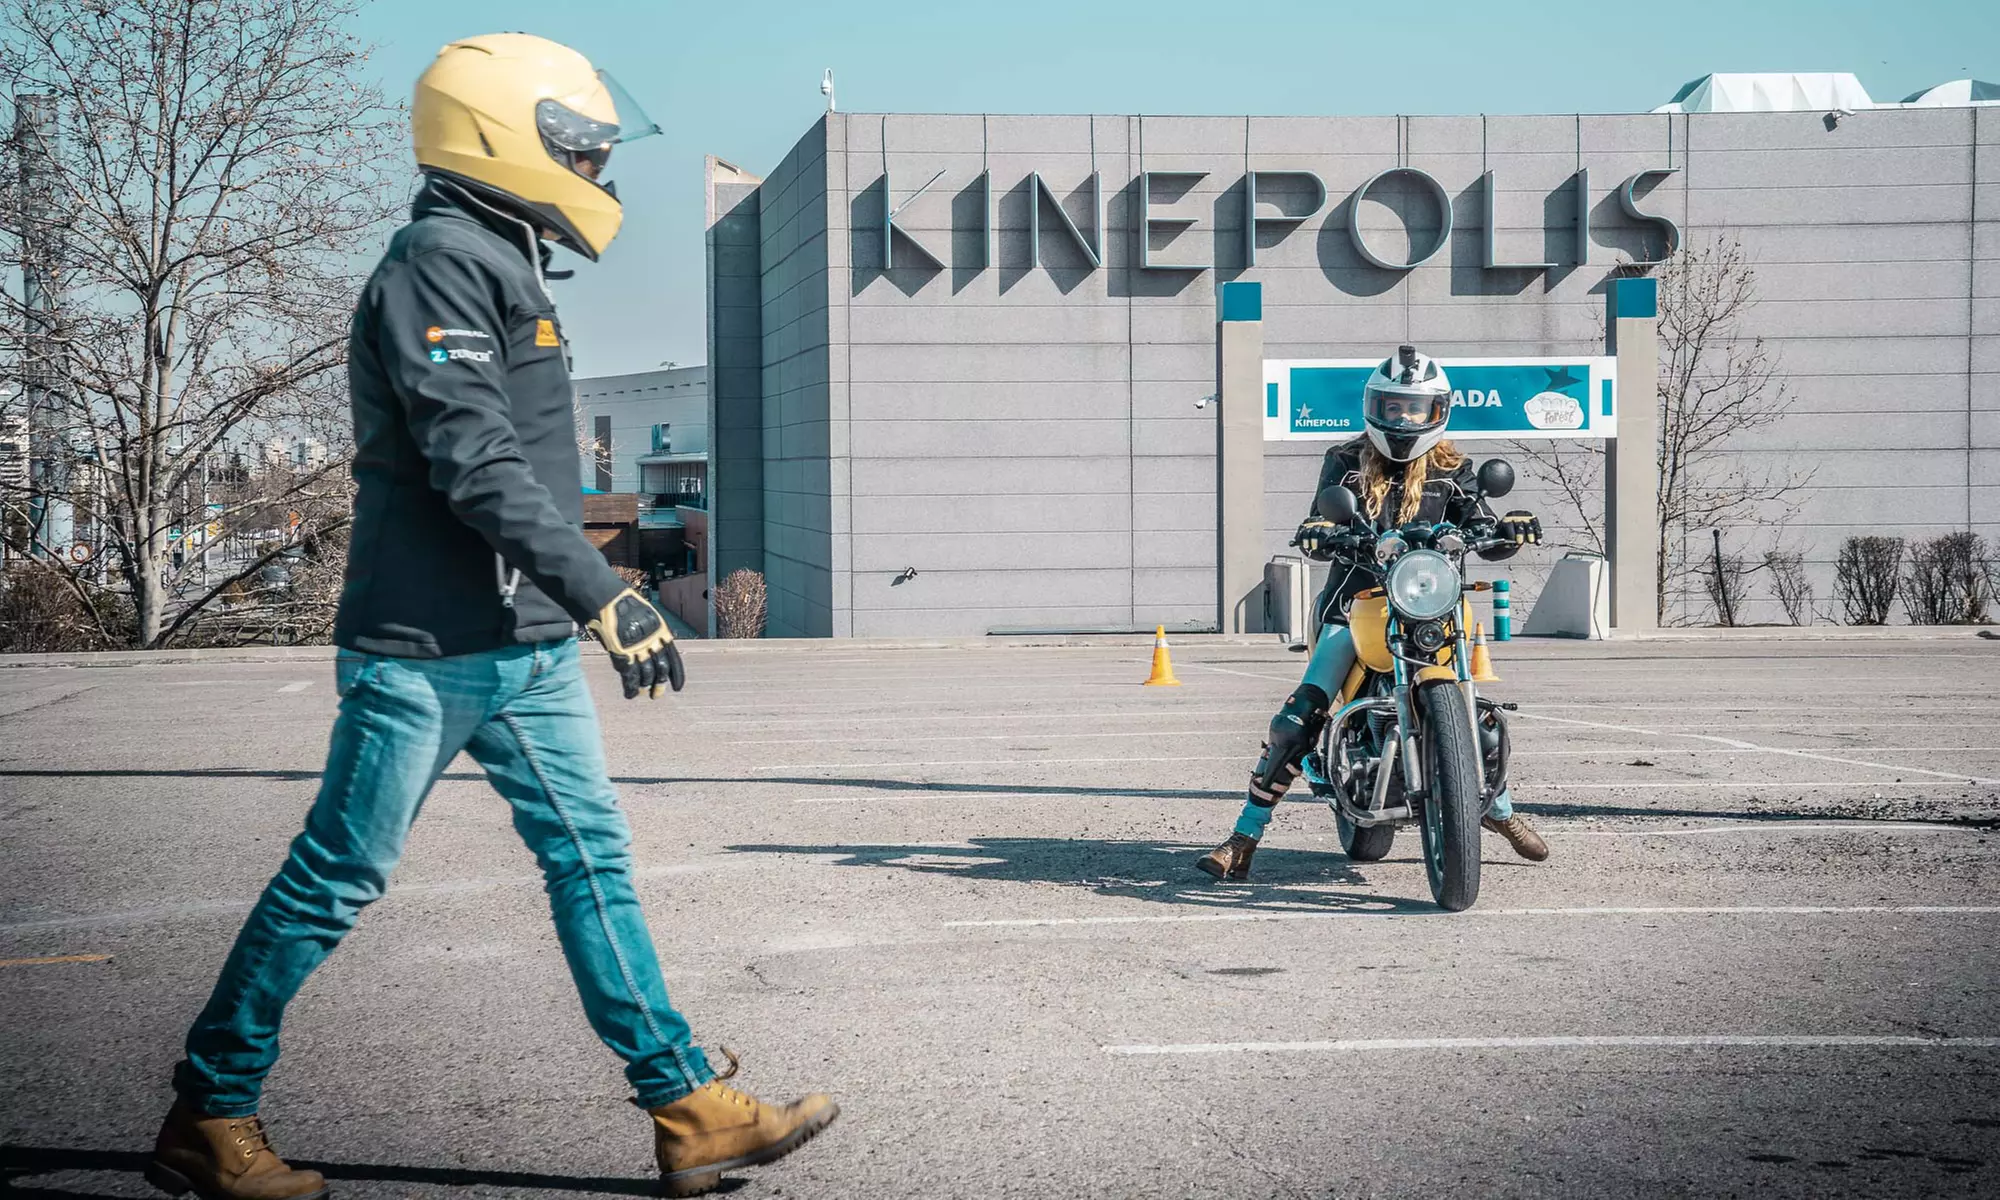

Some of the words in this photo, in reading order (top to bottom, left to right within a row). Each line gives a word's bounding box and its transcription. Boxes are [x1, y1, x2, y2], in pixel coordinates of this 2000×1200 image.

[884, 167, 1681, 270] KINEPOLIS
[1449, 389, 1503, 408] ADA
[1295, 418, 1350, 427] KINEPOLIS
[1544, 411, 1574, 424] forest
